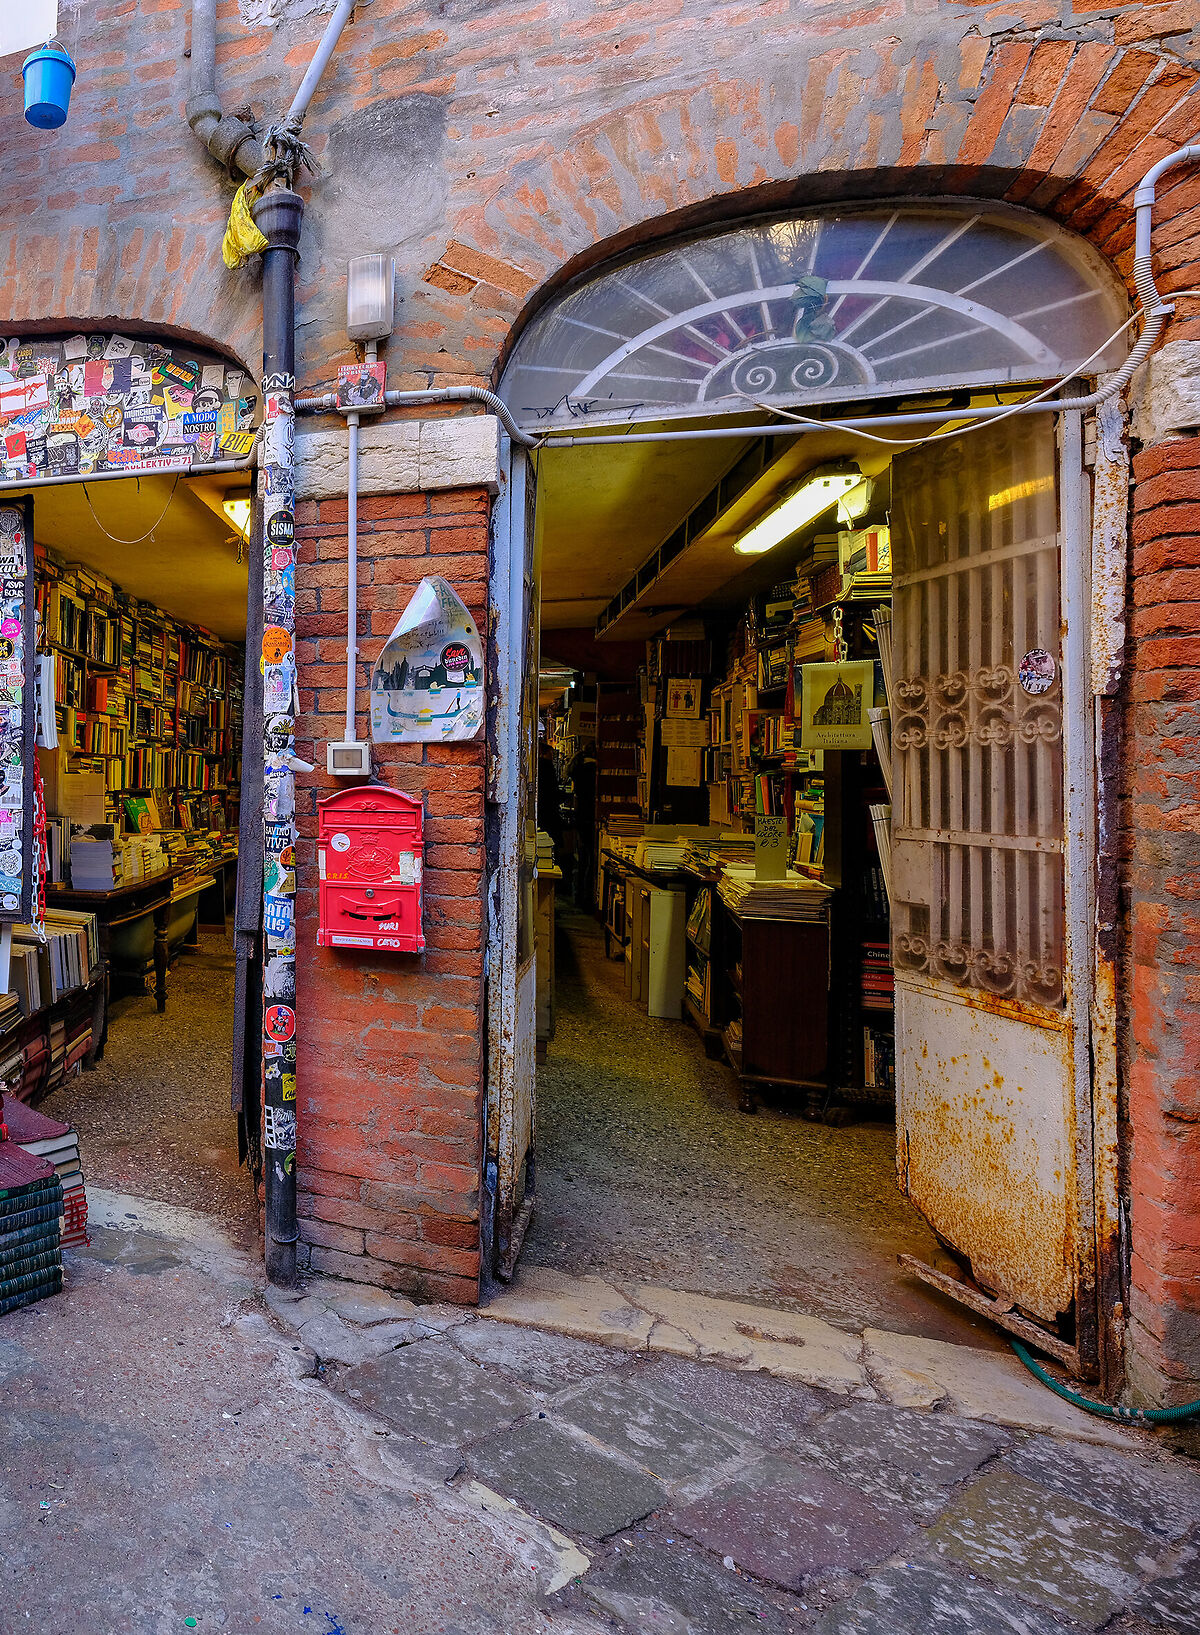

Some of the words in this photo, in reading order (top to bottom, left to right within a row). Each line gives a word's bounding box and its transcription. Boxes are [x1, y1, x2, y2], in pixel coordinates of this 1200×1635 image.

[193, 412, 216, 422] MODO
[184, 422, 216, 433] NOSTRO
[223, 434, 252, 452] BVF
[271, 522, 294, 537] SISMA
[332, 812, 408, 826] LETTERE
